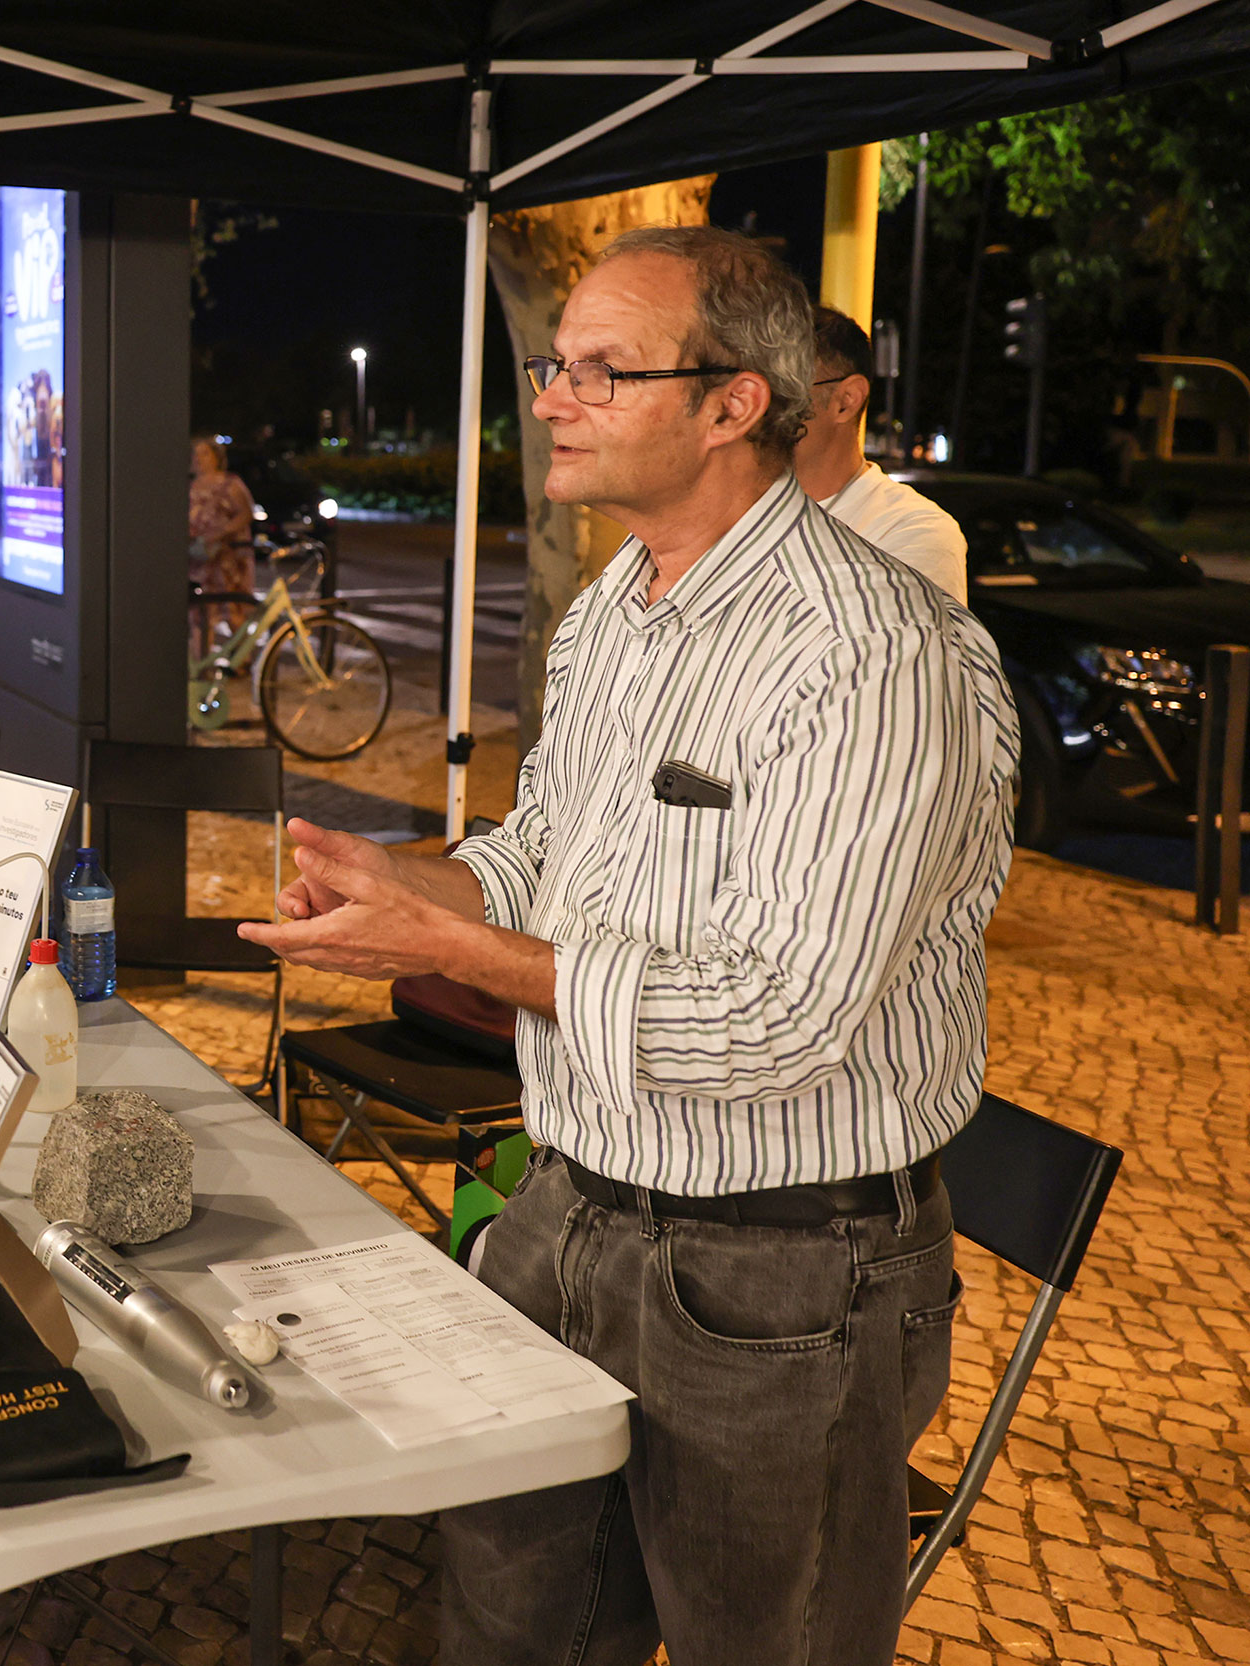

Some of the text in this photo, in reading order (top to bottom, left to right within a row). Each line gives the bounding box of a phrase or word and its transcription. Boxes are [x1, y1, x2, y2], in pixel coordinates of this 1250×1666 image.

[260, 1263, 280, 1271] MEU
[282, 1256, 321, 1268] DESAFIO
[335, 1243, 389, 1258] MOVIMENTO
[24, 1381, 69, 1400] TEST
